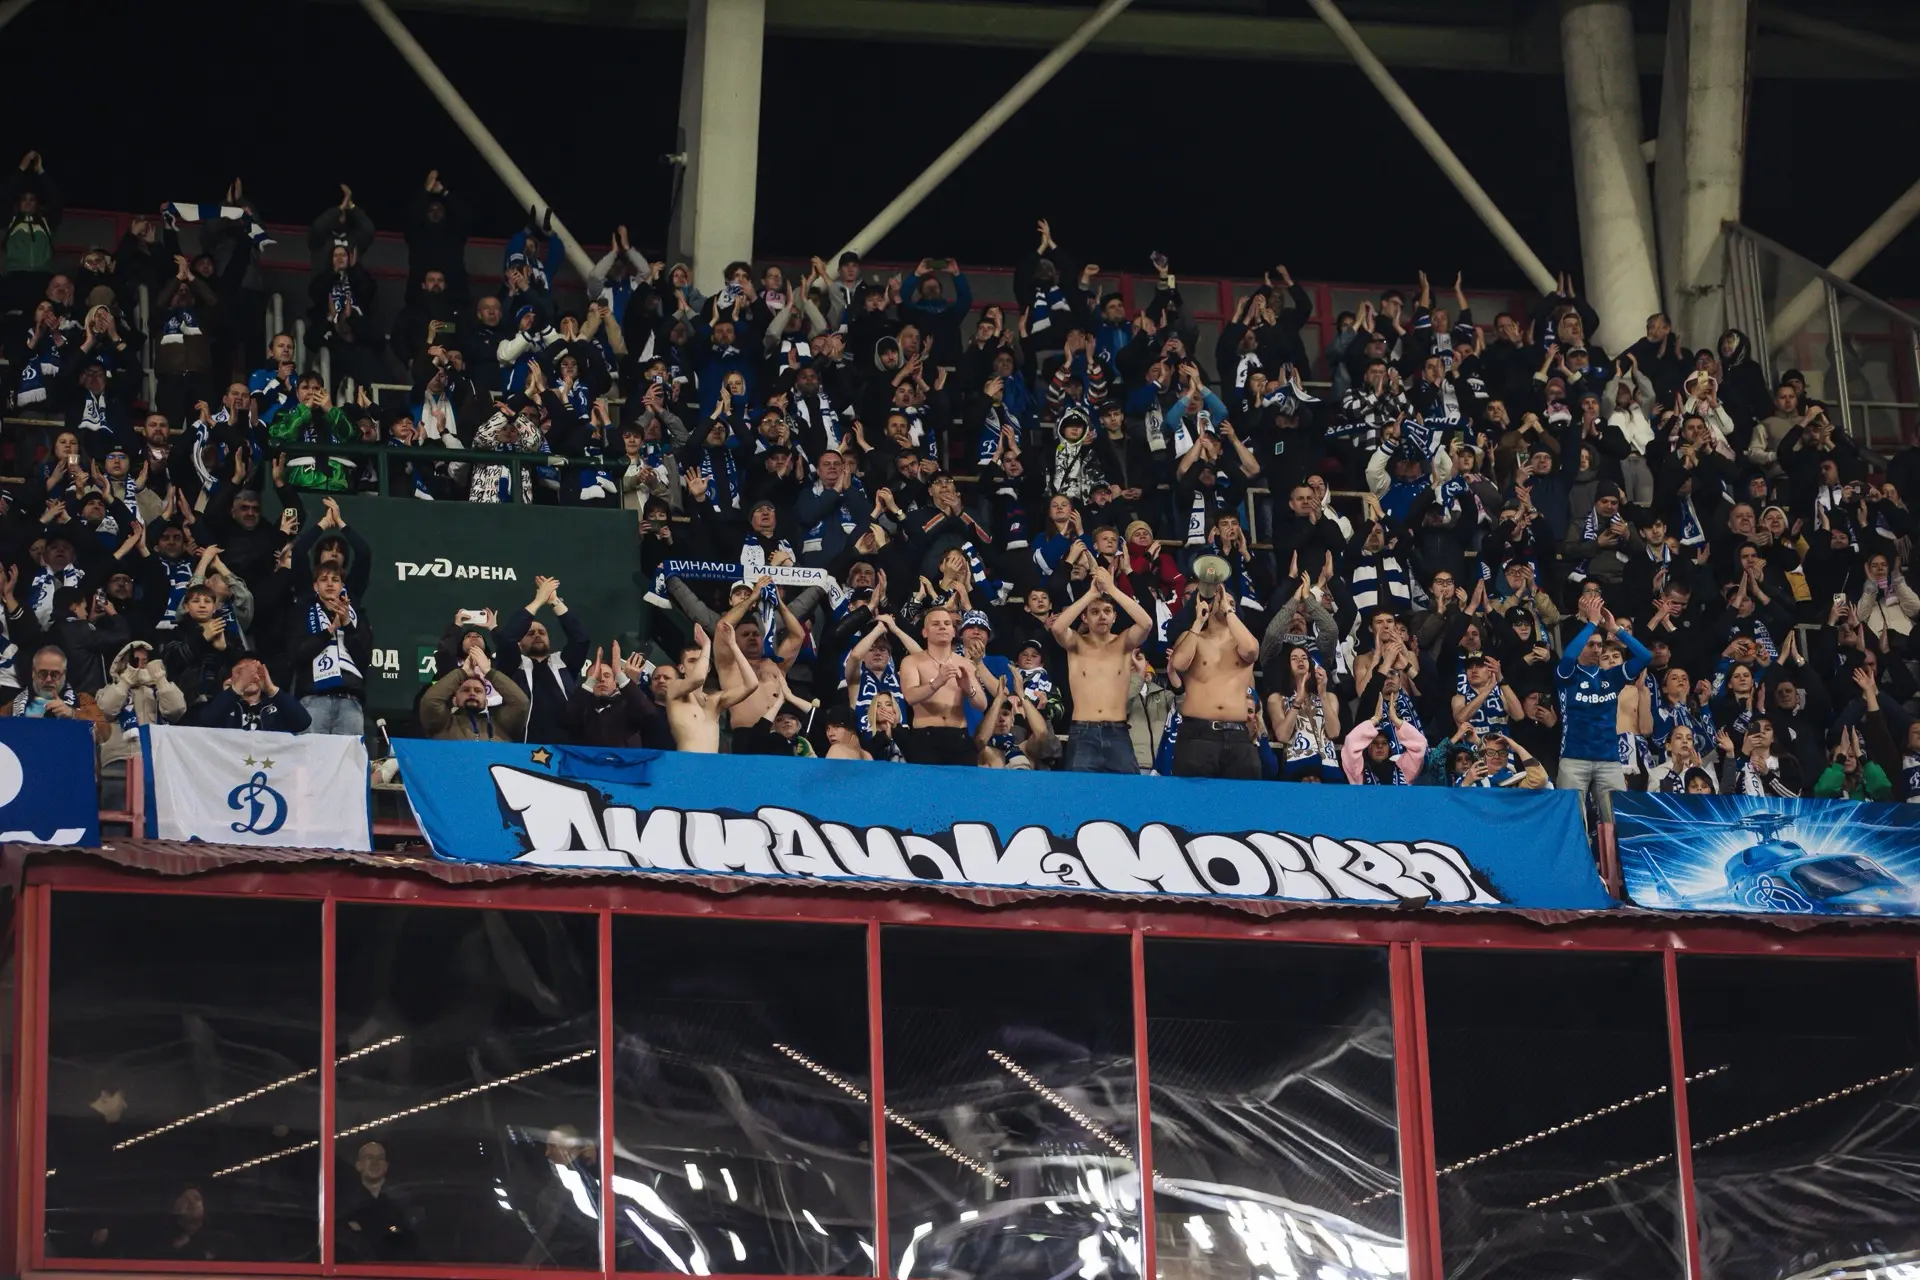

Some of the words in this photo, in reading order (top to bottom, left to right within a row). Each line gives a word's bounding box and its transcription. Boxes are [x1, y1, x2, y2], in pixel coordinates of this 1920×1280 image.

[454, 565, 518, 581] АРЕНА
[669, 560, 736, 573] ДИНАМО
[752, 566, 823, 579] МОСКВА
[368, 649, 400, 671] ОД
[382, 672, 399, 680] EXIT
[1575, 691, 1617, 704] BetBoom
